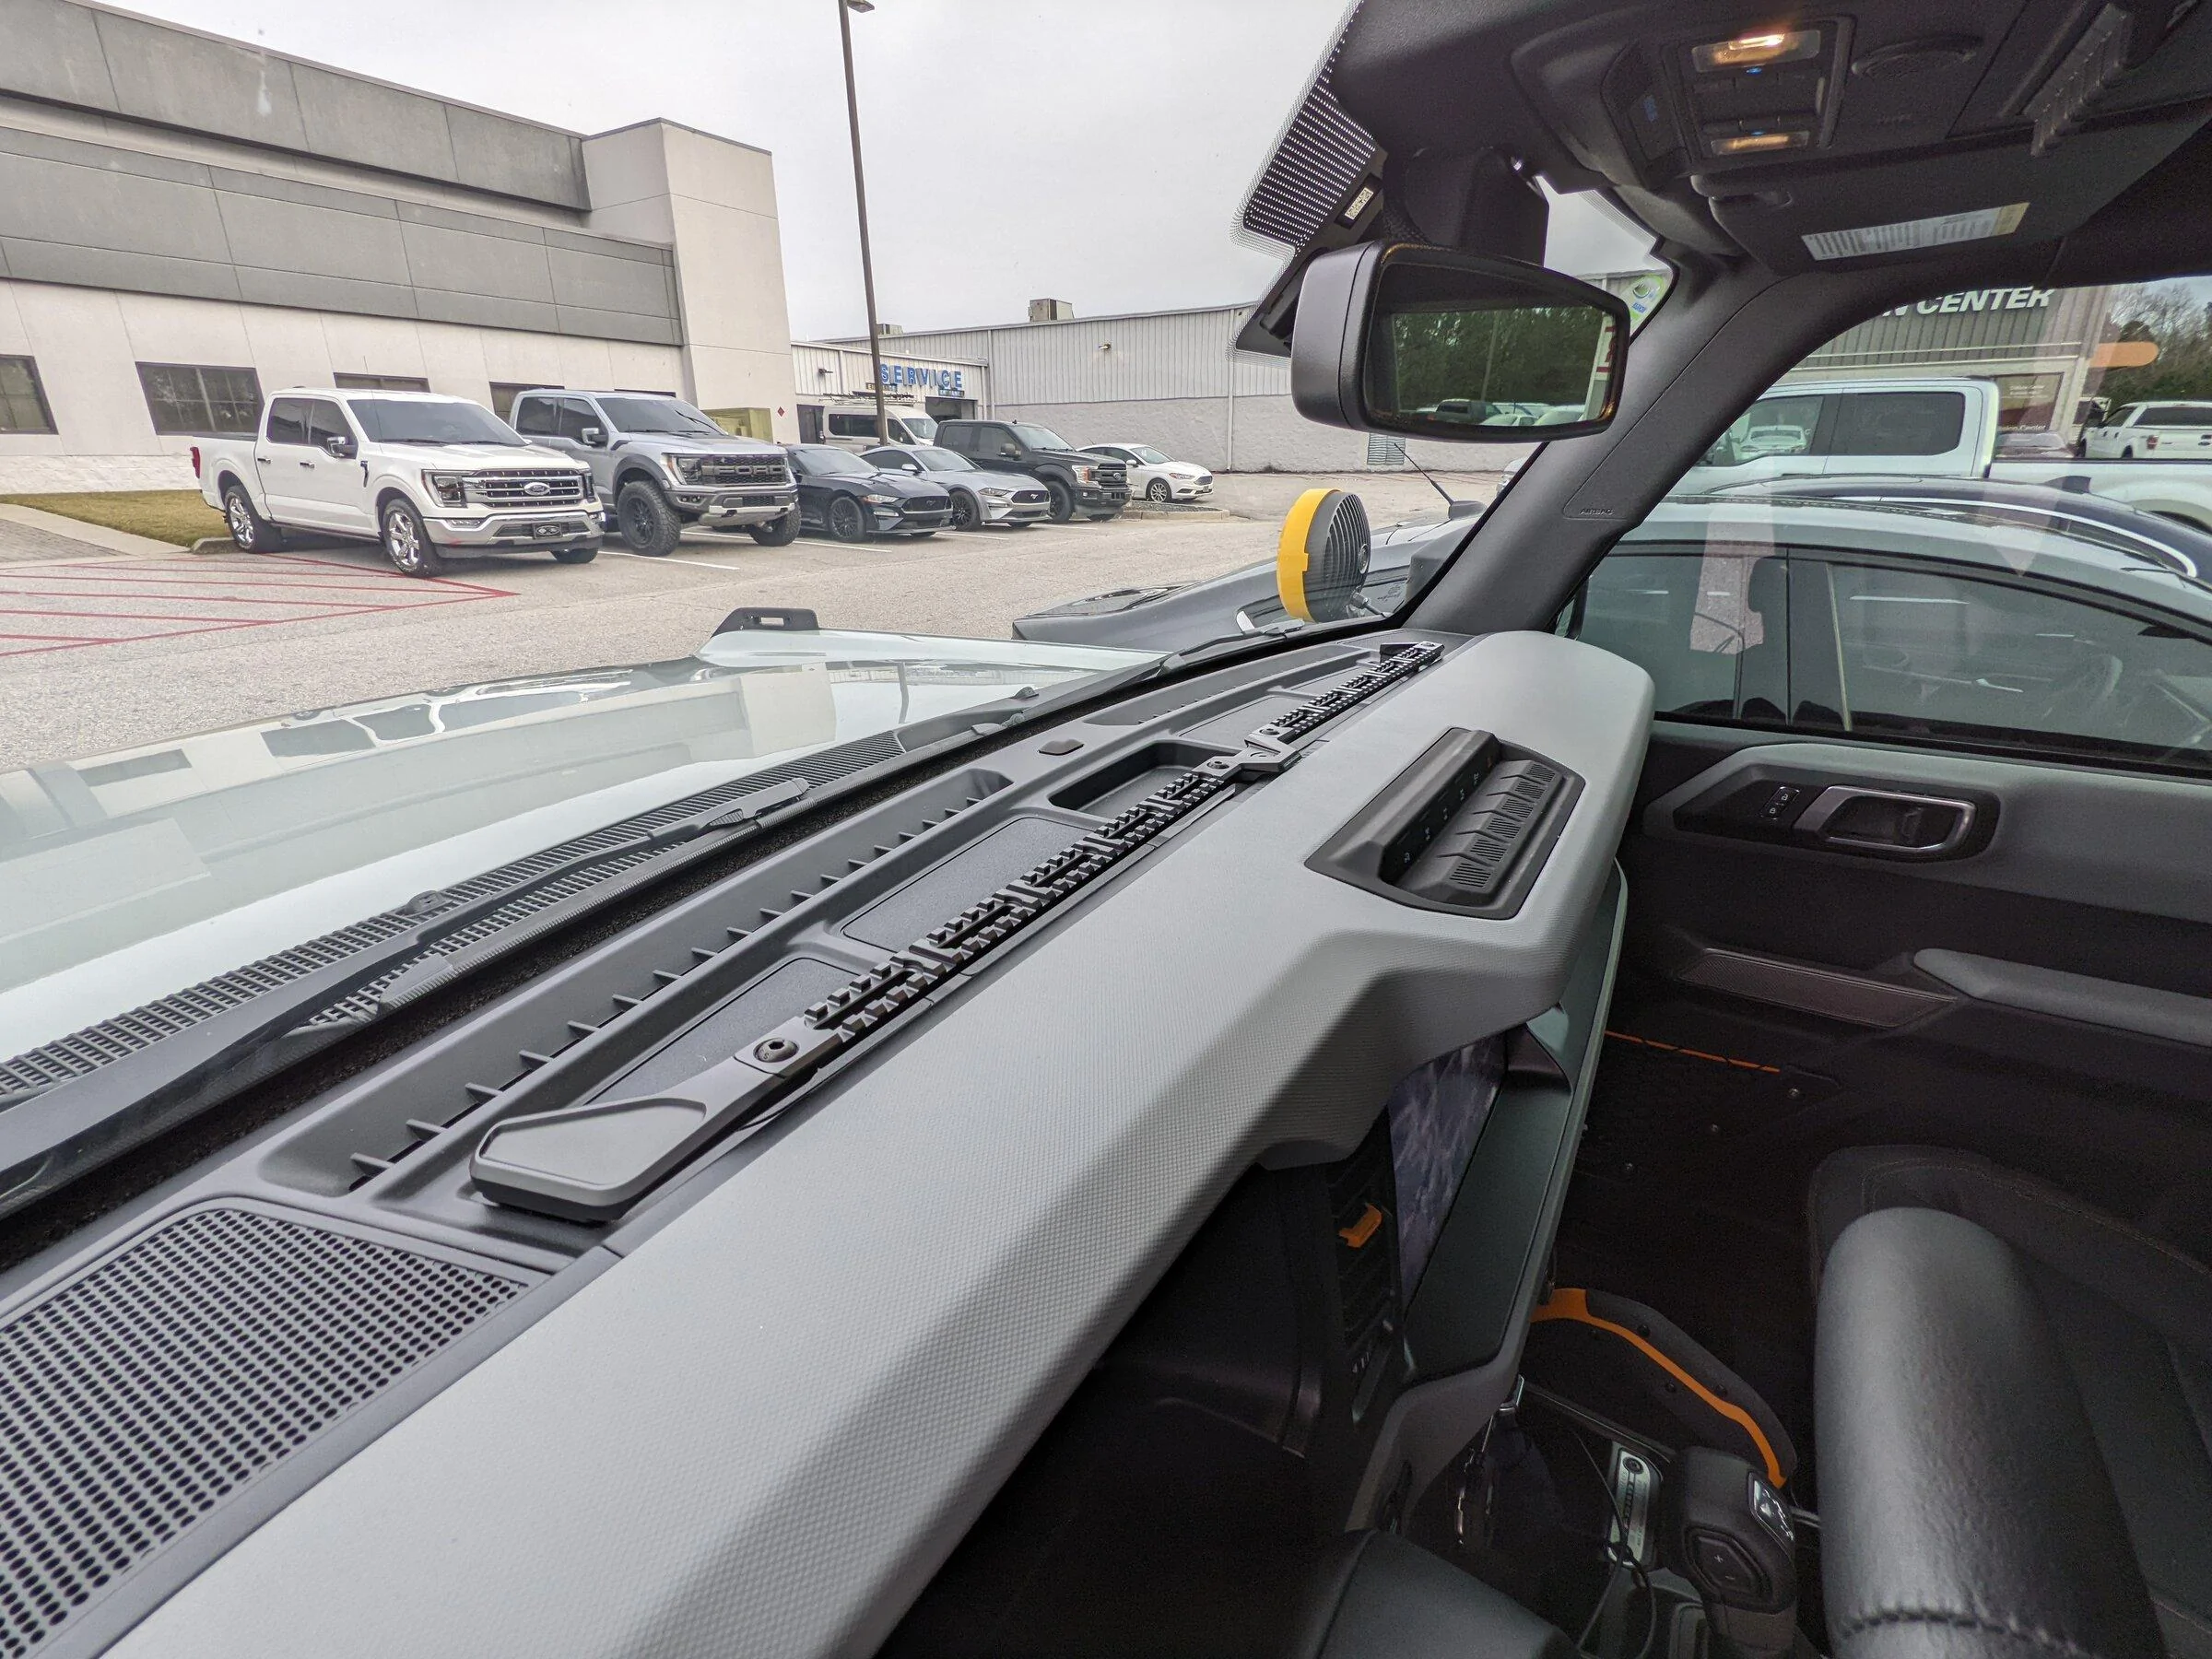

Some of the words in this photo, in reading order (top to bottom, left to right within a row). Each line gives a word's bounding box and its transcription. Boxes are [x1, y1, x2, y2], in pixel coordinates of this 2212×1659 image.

[1917, 286, 2055, 315] CENTER
[880, 364, 962, 387] SERVICE
[714, 465, 785, 477] FORD
